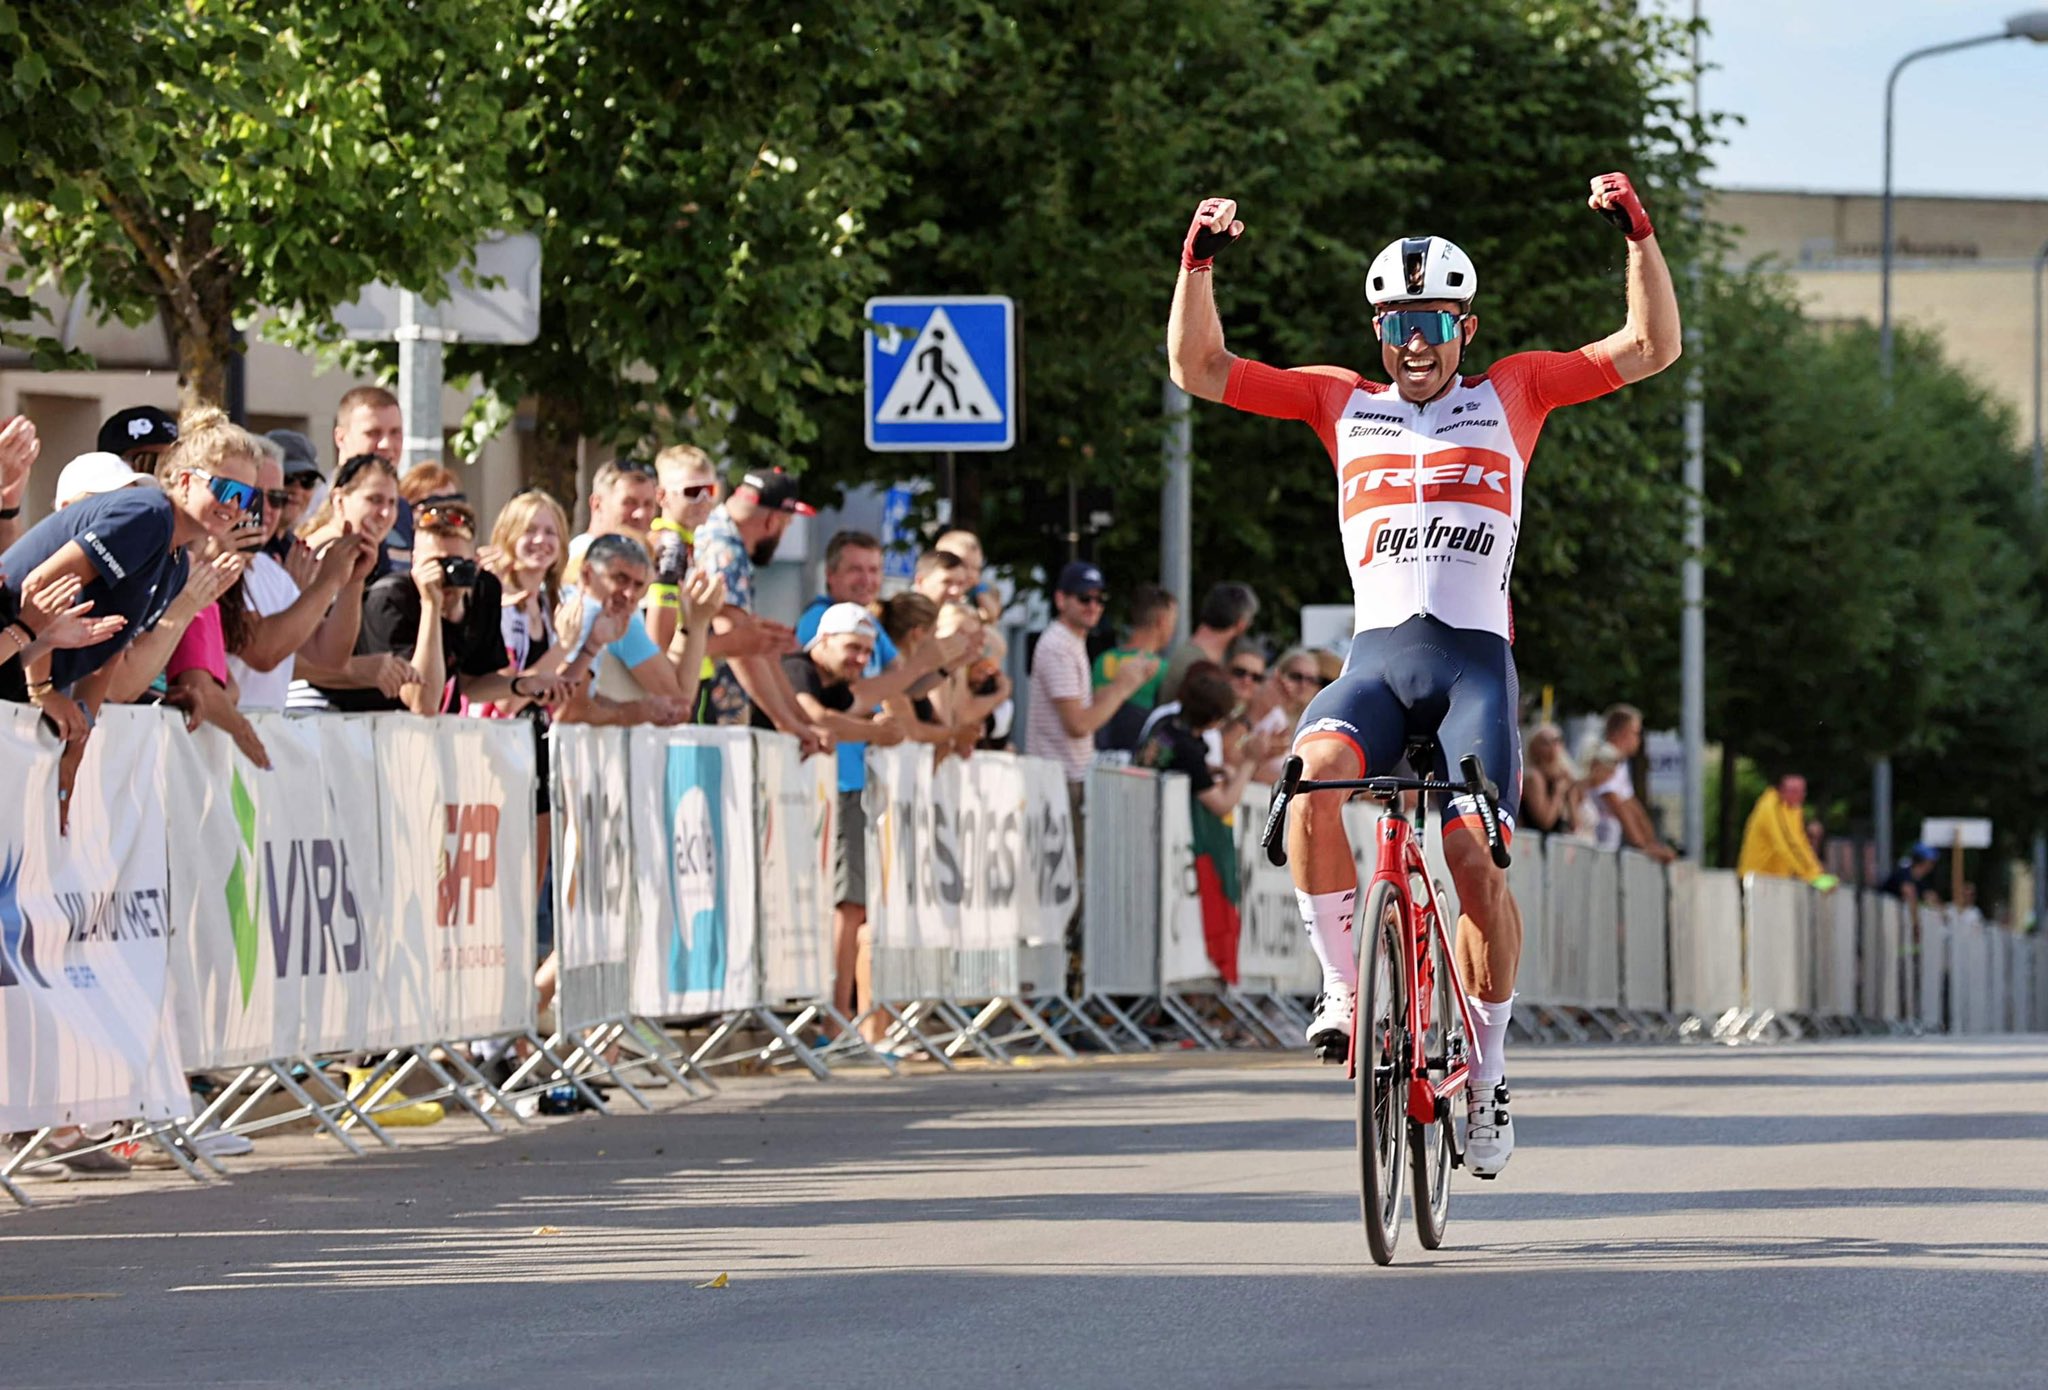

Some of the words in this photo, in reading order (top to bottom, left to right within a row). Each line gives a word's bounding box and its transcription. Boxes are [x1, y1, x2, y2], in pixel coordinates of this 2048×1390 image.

[1352, 411, 1404, 424] SRAM
[1348, 425, 1403, 438] Santini
[1435, 419, 1499, 435] BONTRAGER
[1343, 464, 1508, 502] TREK
[1359, 517, 1495, 567] Segafredo
